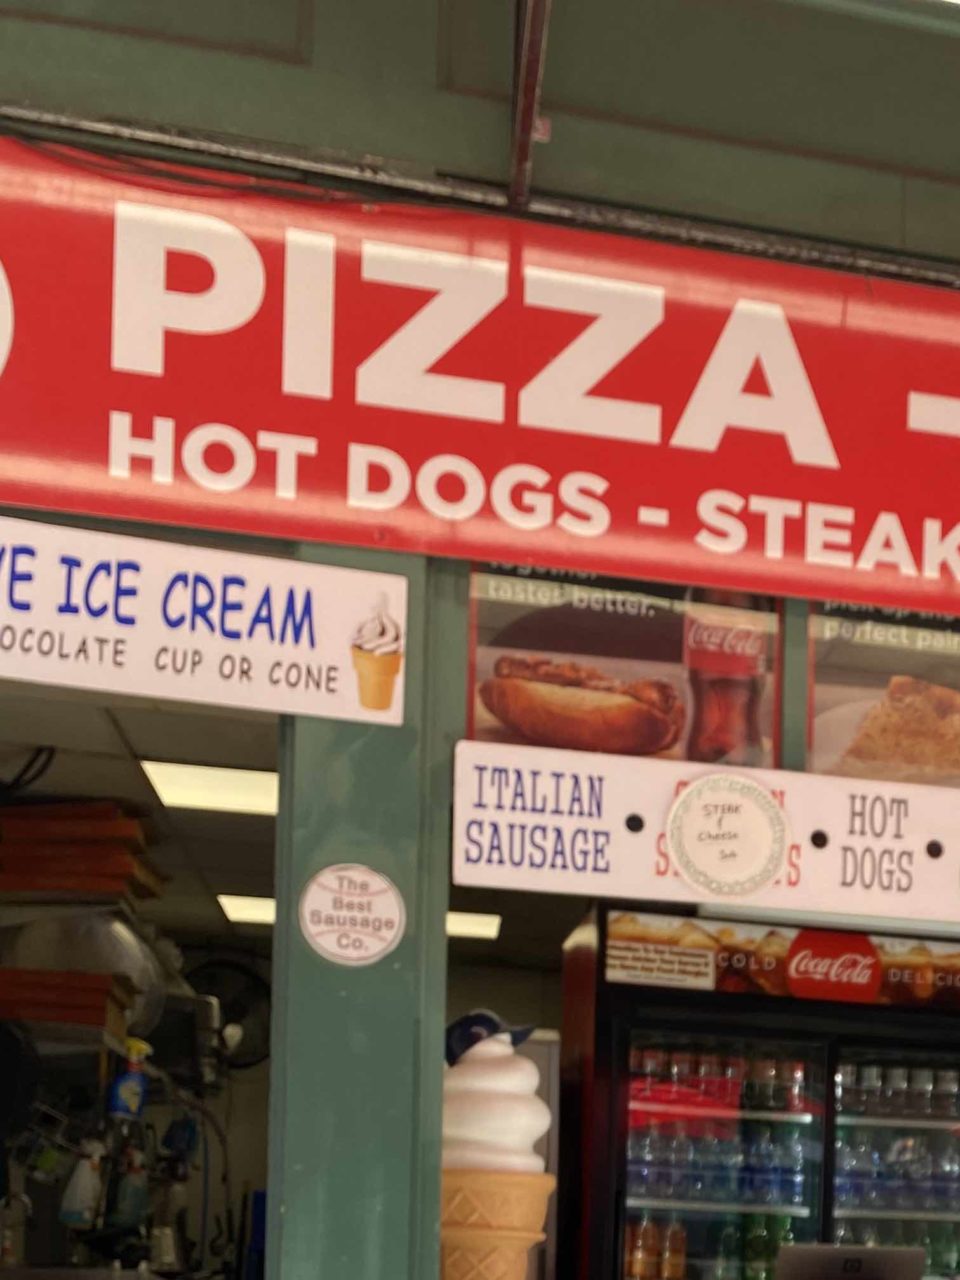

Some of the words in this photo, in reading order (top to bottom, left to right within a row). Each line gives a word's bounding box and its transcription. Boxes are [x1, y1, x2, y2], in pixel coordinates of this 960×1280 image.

[110, 200, 840, 470] PIZZA
[107, 410, 318, 500] HOT
[345, 442, 611, 537] DOGS
[0, 546, 36, 611] E
[57, 555, 140, 625] ICE
[162, 571, 316, 649] CREAM
[154, 646, 202, 676] CUP
[219, 655, 253, 682] OR
[269, 661, 339, 693] CONE
[473, 765, 605, 818] ITALIAN
[848, 793, 909, 840] HOT
[464, 820, 612, 874] SAUSAGE
[840, 846, 913, 893] DOGS
[332, 897, 372, 914] Best
[337, 875, 370, 892] The
[310, 909, 395, 931] Sausage
[336, 933, 369, 951] Co.
[716, 950, 777, 971] COLD
[788, 949, 875, 986] Coca-Cola
